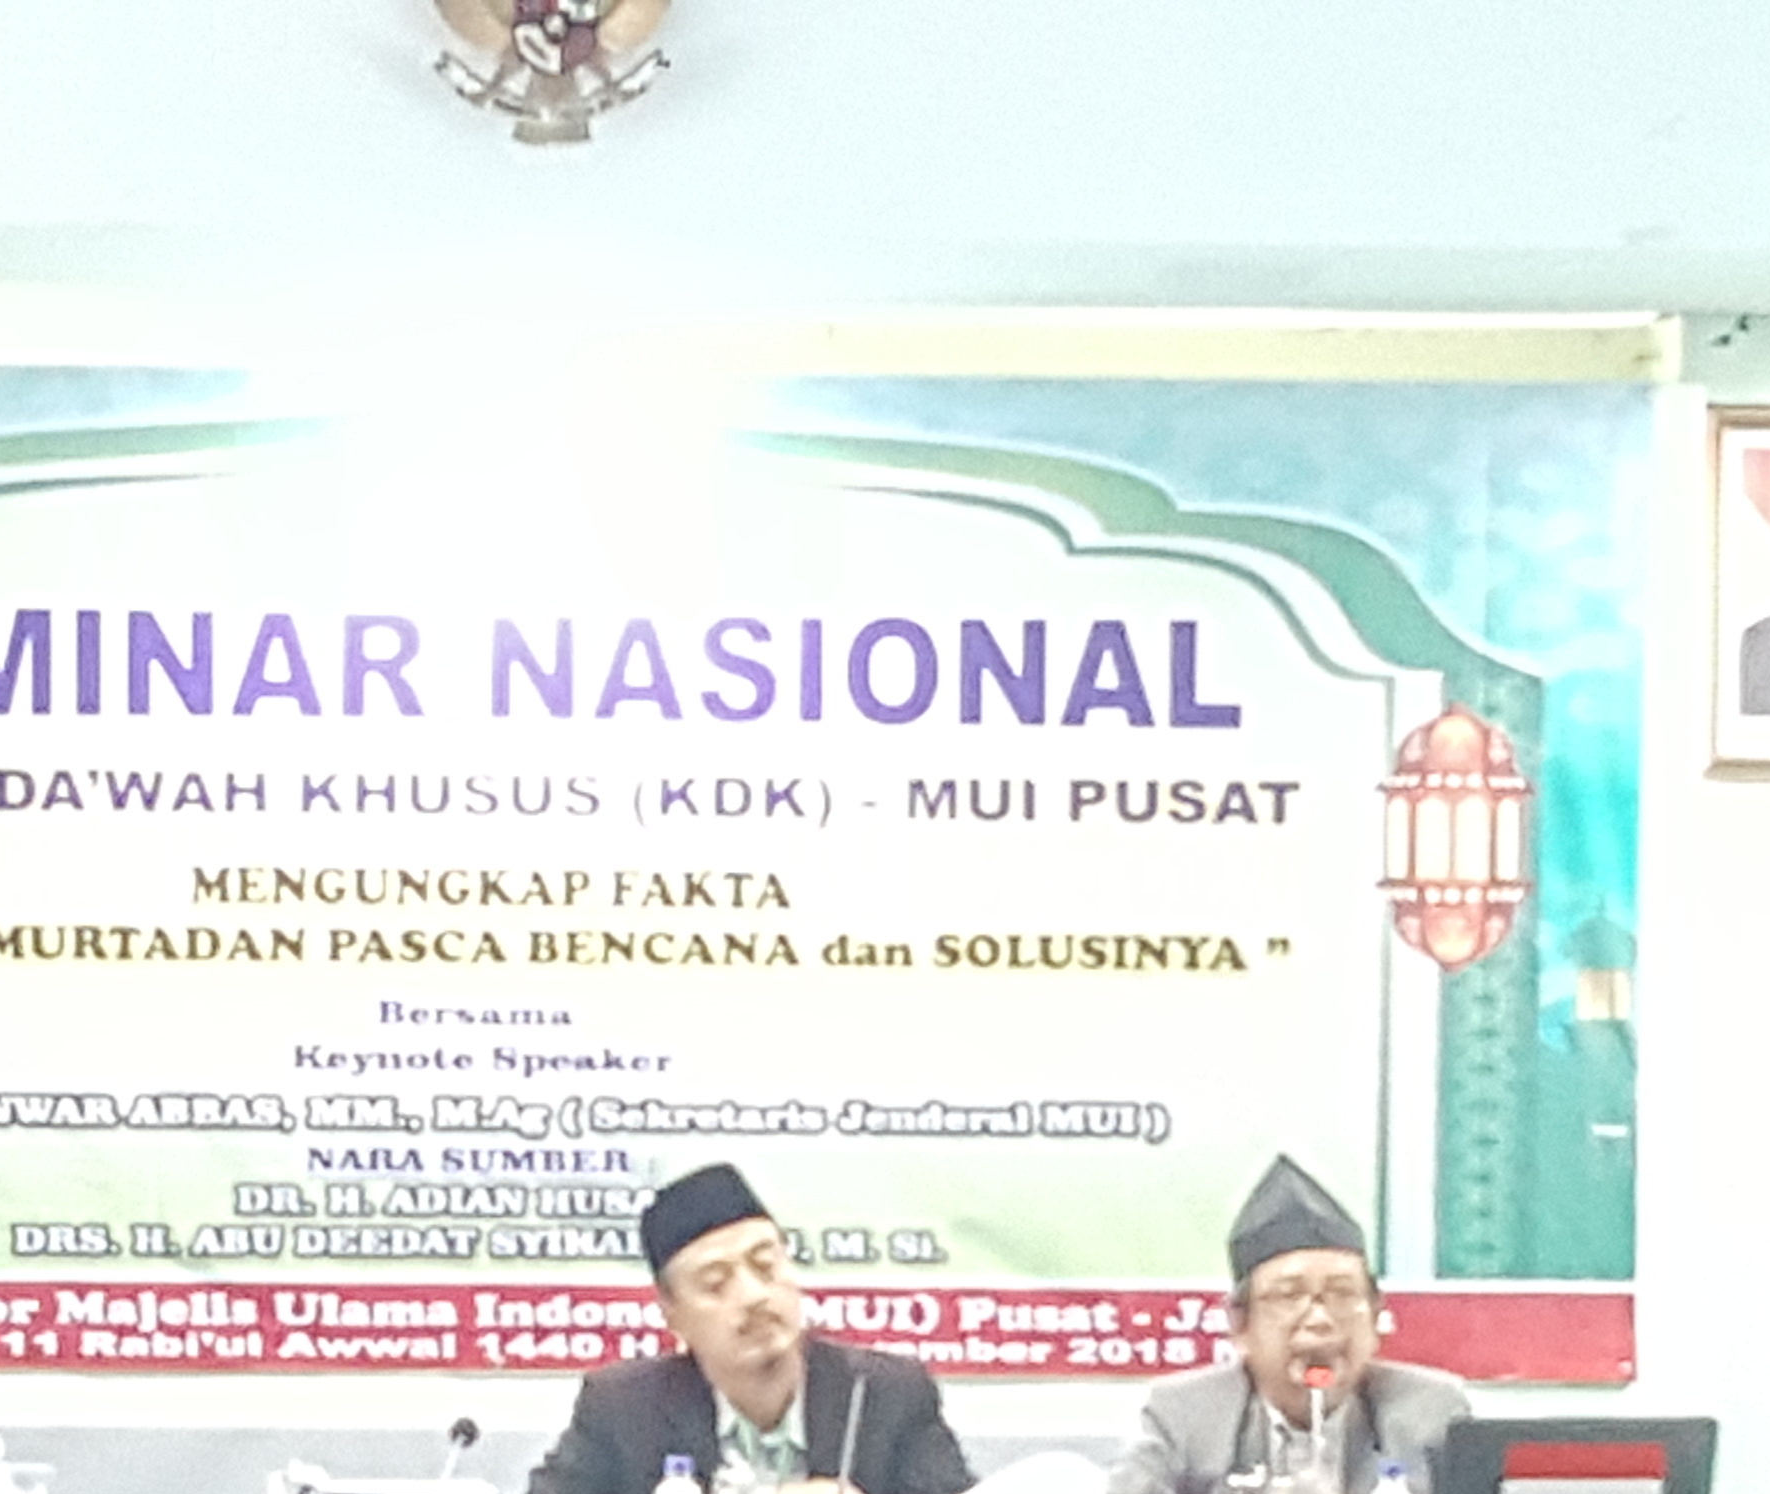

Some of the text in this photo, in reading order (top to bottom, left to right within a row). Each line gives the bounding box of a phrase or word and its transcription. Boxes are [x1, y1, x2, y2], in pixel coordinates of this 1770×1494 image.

[491, 617, 1243, 730] NASIONAL
[301, 775, 601, 815] KHUSUS
[633, 777, 832, 828] (KDK)
[908, 778, 1036, 822] MUI
[1068, 779, 1301, 826] PUSAT
[192, 866, 792, 910] MENGUNGKAP FAKTA
[328, 928, 508, 965] PASCA
[528, 930, 800, 968] BENCANA
[820, 933, 914, 968] dan
[932, 934, 1249, 973] SOLUSINYA
[379, 1000, 573, 1026] Bersama
[293, 1045, 671, 1079] Keynote Speaker
[128, 1095, 295, 1133] ABBAS,
[306, 1096, 423, 1134] MM.,
[590, 1097, 828, 1134] Sekretaris
[836, 1101, 1033, 1137] Jenderal
[1039, 1102, 1138, 1138] MUI
[307, 1147, 632, 1174] NARA SUMBER
[235, 1184, 315, 1216] DR.
[325, 1184, 374, 1217] H.
[383, 1184, 528, 1217] ADIAN
[12, 1223, 121, 1256] DRS.
[130, 1224, 180, 1257] H.
[188, 1225, 285, 1257] ABU
[293, 1226, 479, 1258] DEEDAT
[822, 1226, 882, 1263] M.
[53, 1290, 258, 1333] Majelis
[273, 1291, 459, 1327] Ulama
[473, 1292, 667, 1329] Indone
[799, 1293, 940, 1335] MUI)
[957, 1296, 1120, 1333] Pusat
[78, 1330, 264, 1359] Rabi'ul
[277, 1331, 458, 1360] Awwal
[476, 1332, 603, 1362] 1440
[619, 1333, 660, 1360] H
[1066, 1336, 1196, 1364] 2018
